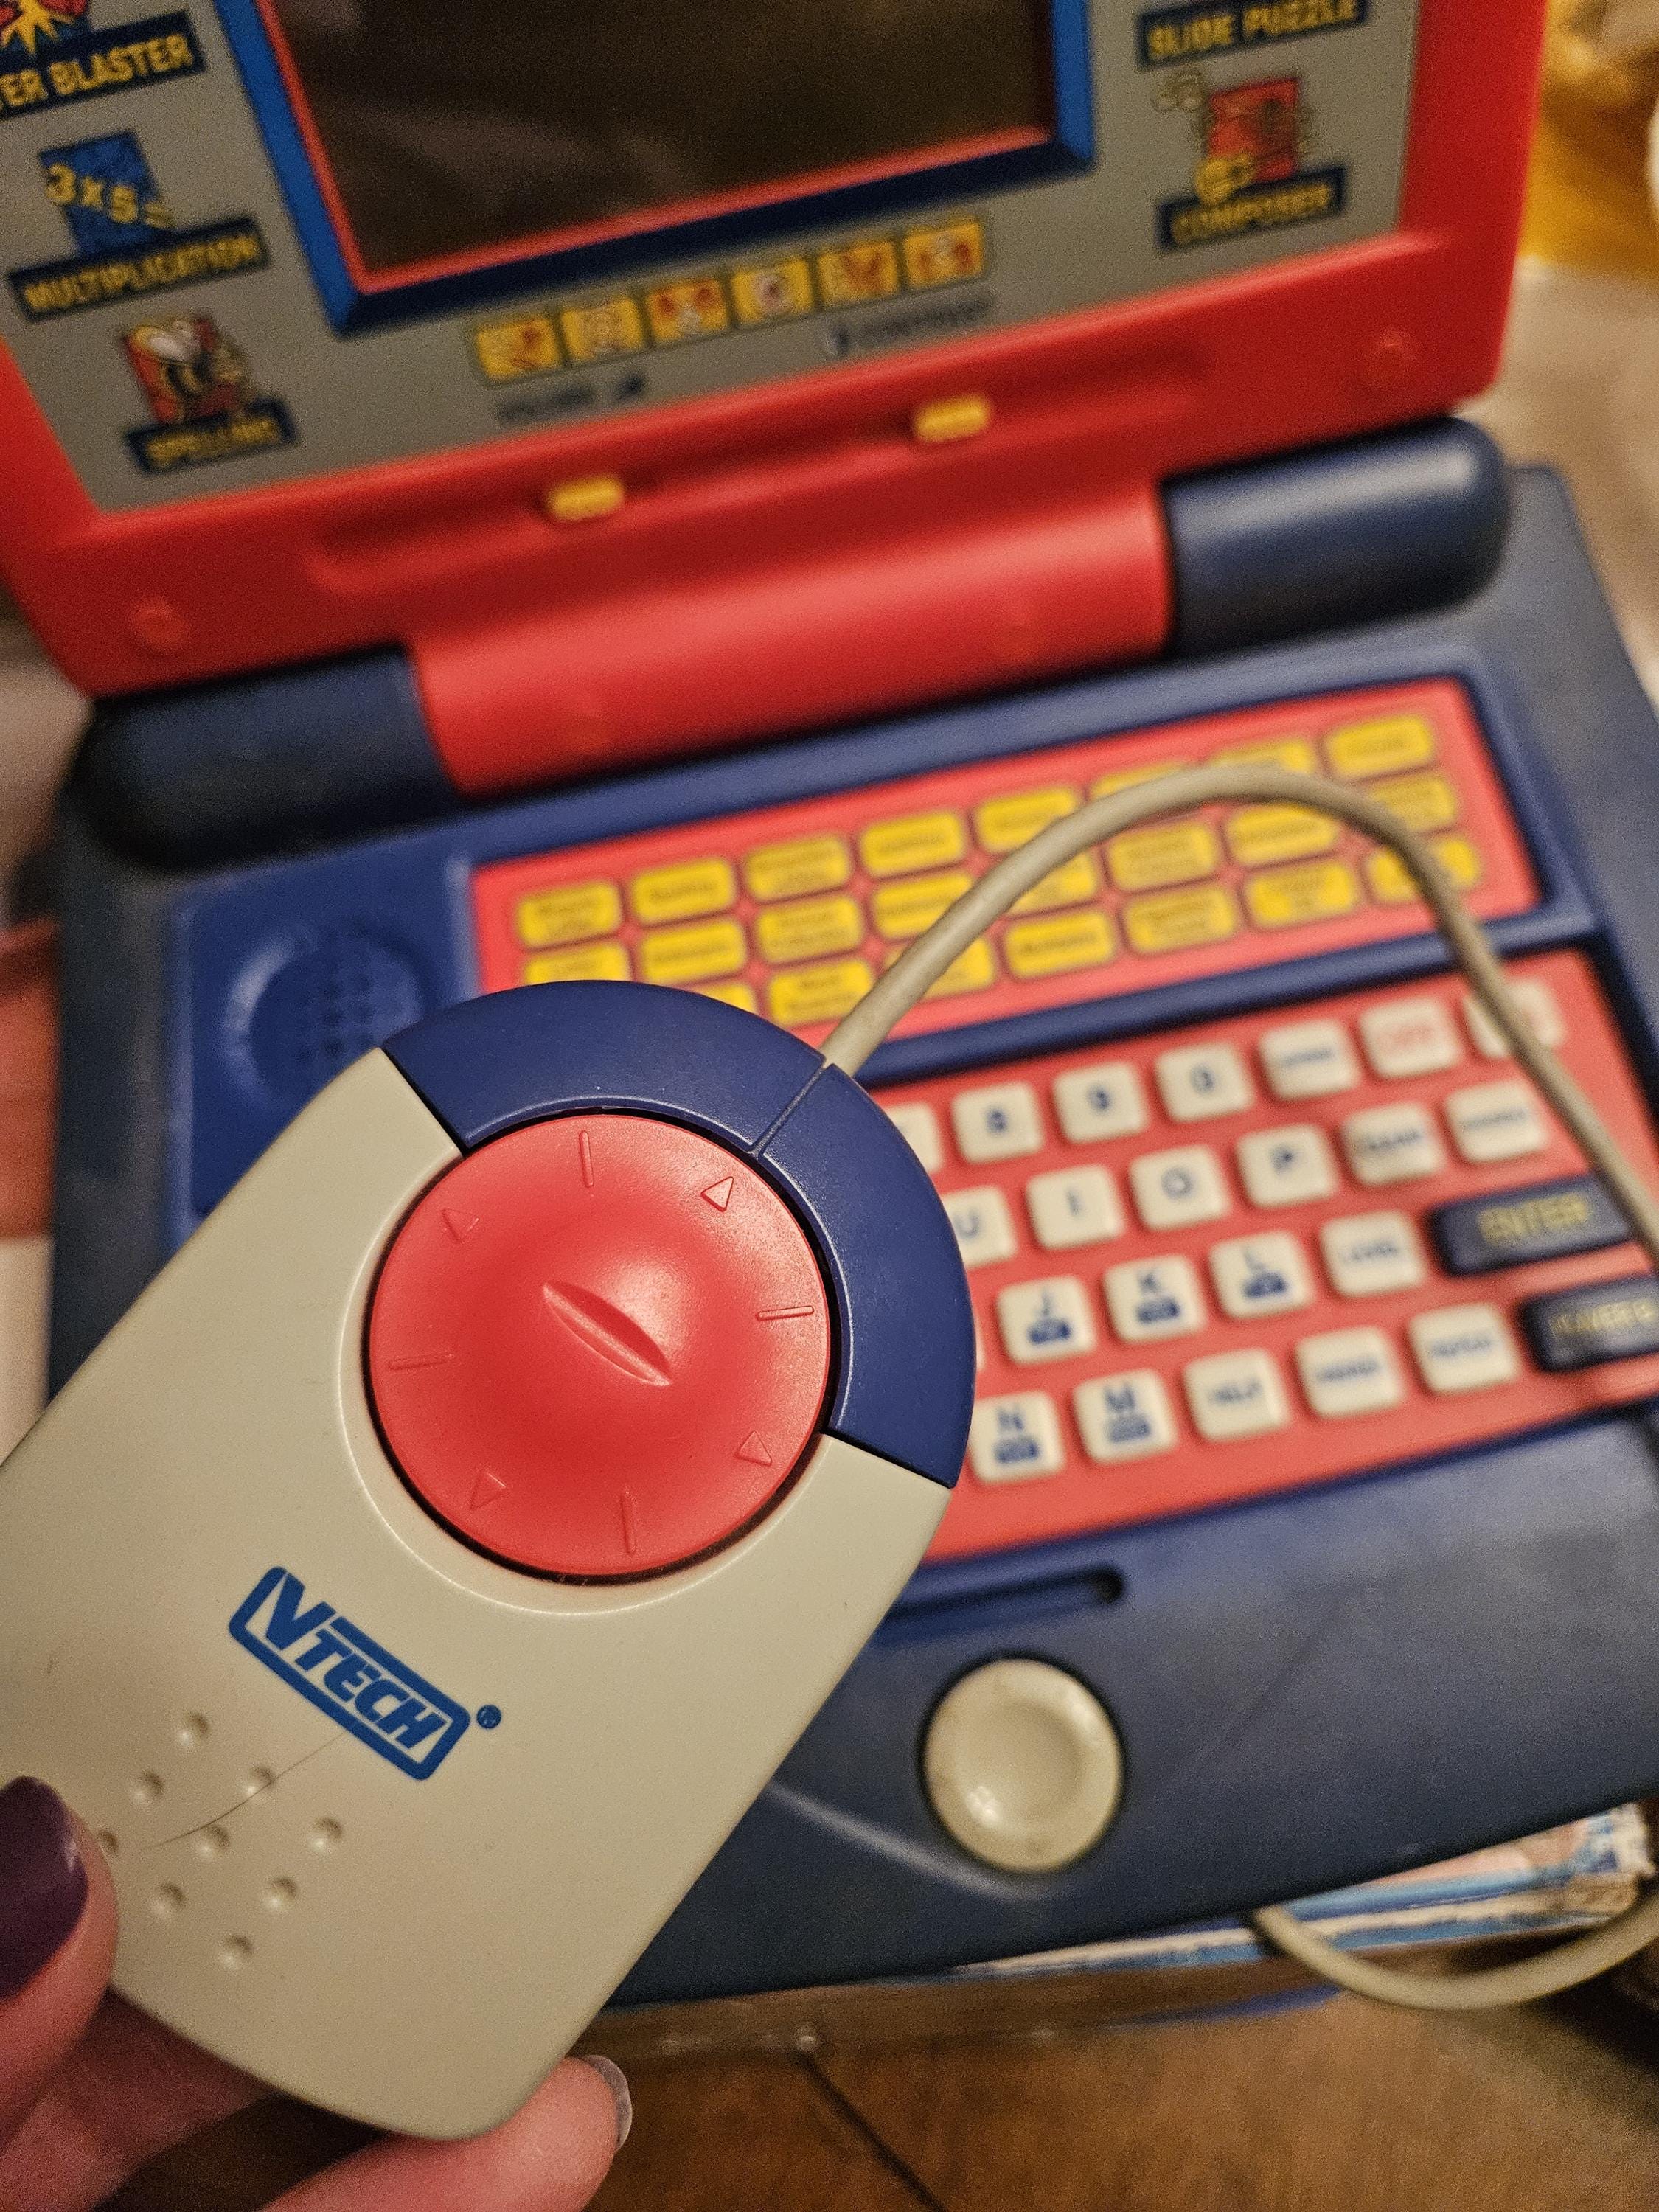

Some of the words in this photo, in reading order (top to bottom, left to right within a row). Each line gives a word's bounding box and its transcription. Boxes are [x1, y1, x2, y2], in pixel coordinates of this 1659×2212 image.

[0, 69, 48, 108] ER
[49, 32, 194, 95] BLASTER
[46, 162, 74, 205] 3
[111, 186, 137, 223] 5
[24, 234, 258, 313] MULTIPLICATION
[1271, 1144, 1295, 1175] P
[1161, 1166, 1194, 1200] O
[1138, 1268, 1162, 1295] K
[1106, 1382, 1135, 1411] M
[997, 1406, 1023, 1433] N
[262, 1568, 448, 1752] VTECH
